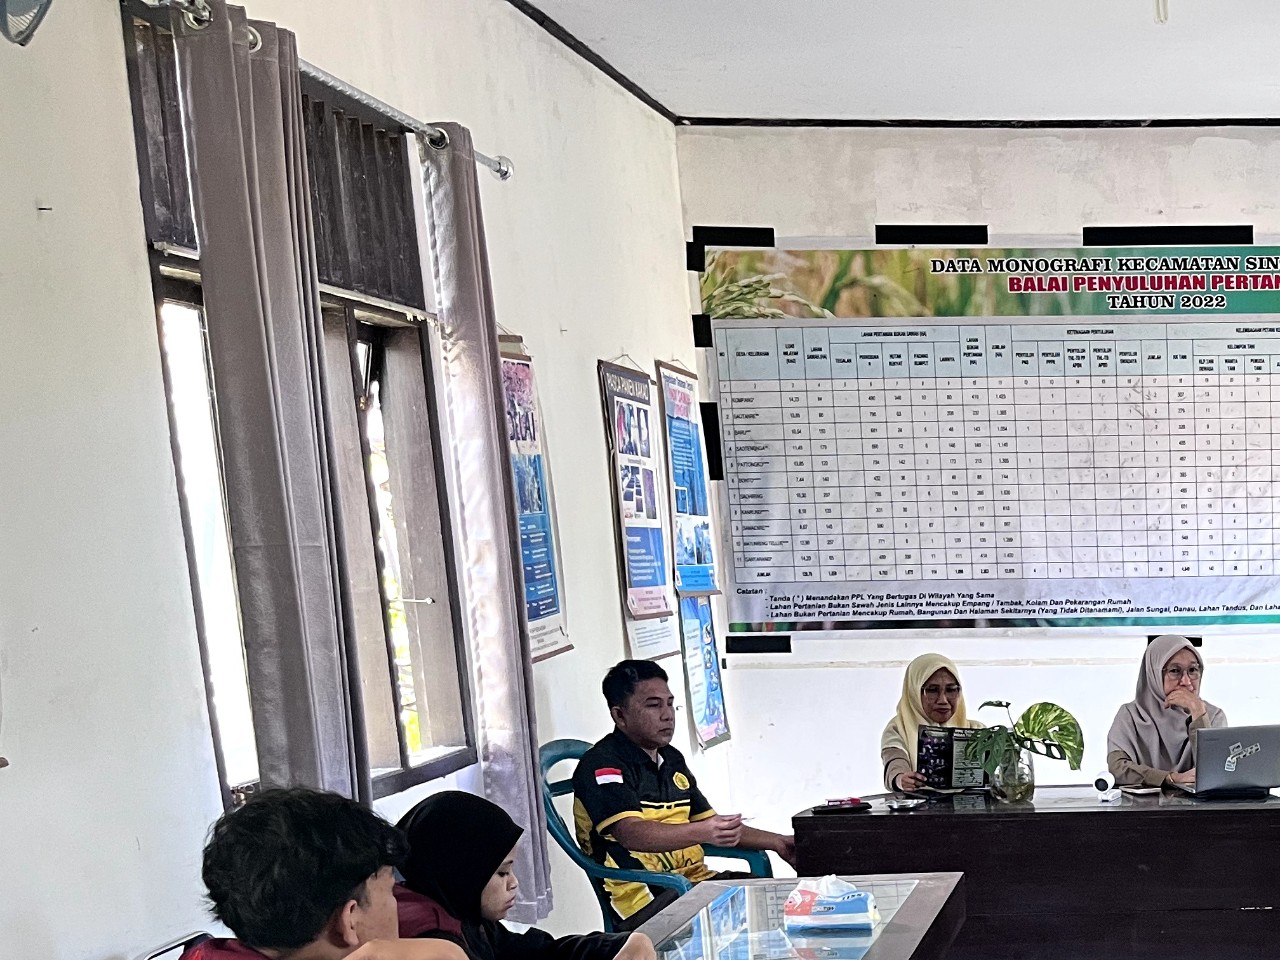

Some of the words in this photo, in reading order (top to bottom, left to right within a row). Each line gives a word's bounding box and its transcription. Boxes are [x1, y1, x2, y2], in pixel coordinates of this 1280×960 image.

[931, 258, 983, 273] DATA
[988, 257, 1112, 273] MONOGRAFI
[1117, 256, 1240, 272] KECAMATAN
[1009, 275, 1069, 292] BALAI
[1074, 274, 1206, 292] PENYULUHAN
[1108, 296, 1175, 310] TAHUN
[1181, 295, 1226, 309] 2022
[867, 593, 884, 601] Yang
[886, 593, 917, 601] Bertugas
[928, 592, 955, 600] Wilayah
[957, 592, 974, 600] Yang
[925, 600, 961, 608] Mencakup
[962, 600, 990, 608] Empang
[1173, 605, 1197, 613] Danau,
[1222, 604, 1248, 612] Tandus,
